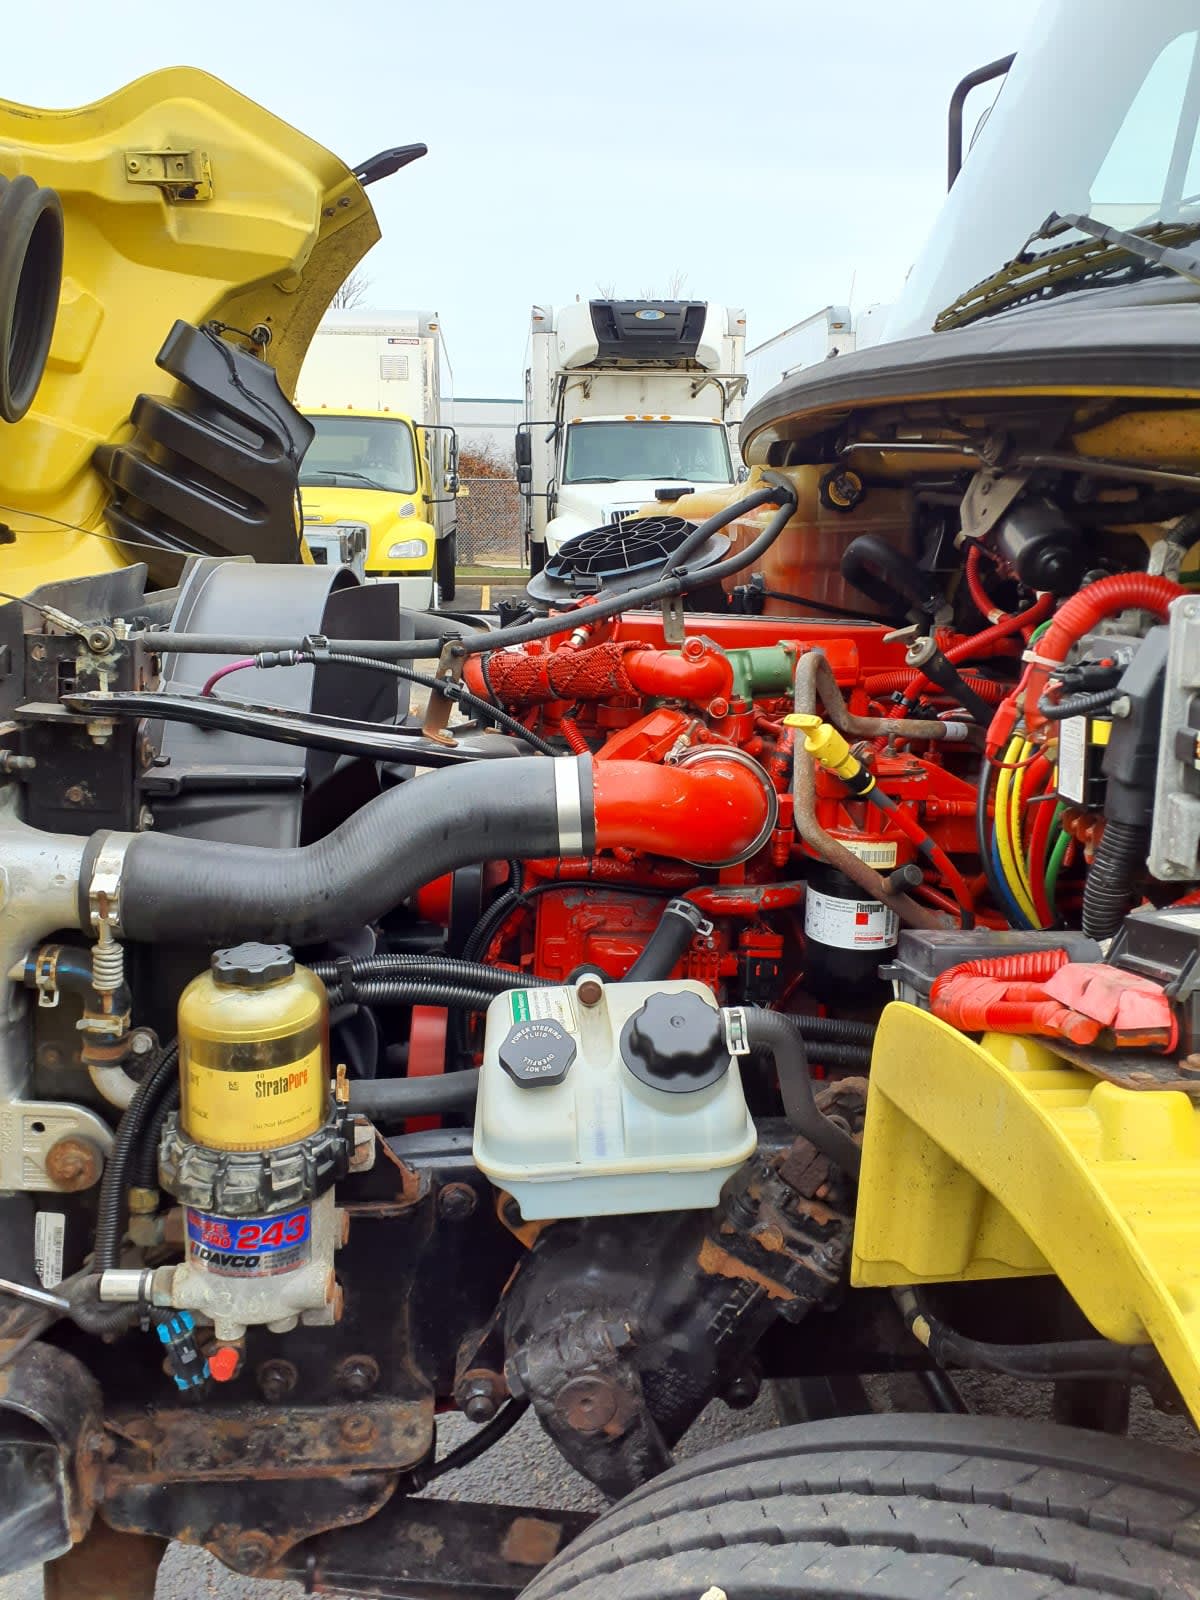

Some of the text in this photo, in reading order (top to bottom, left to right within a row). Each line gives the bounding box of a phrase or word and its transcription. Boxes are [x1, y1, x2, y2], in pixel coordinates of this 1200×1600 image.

[511, 1025, 562, 1044] POWER STEERING
[524, 1031, 548, 1040] FLUID
[523, 1053, 555, 1066] OVERFILL
[525, 1063, 552, 1073] DO NOT
[255, 1069, 308, 1098] StrataPore
[236, 1214, 306, 1250] 243
[200, 1246, 260, 1268] DAVCO
